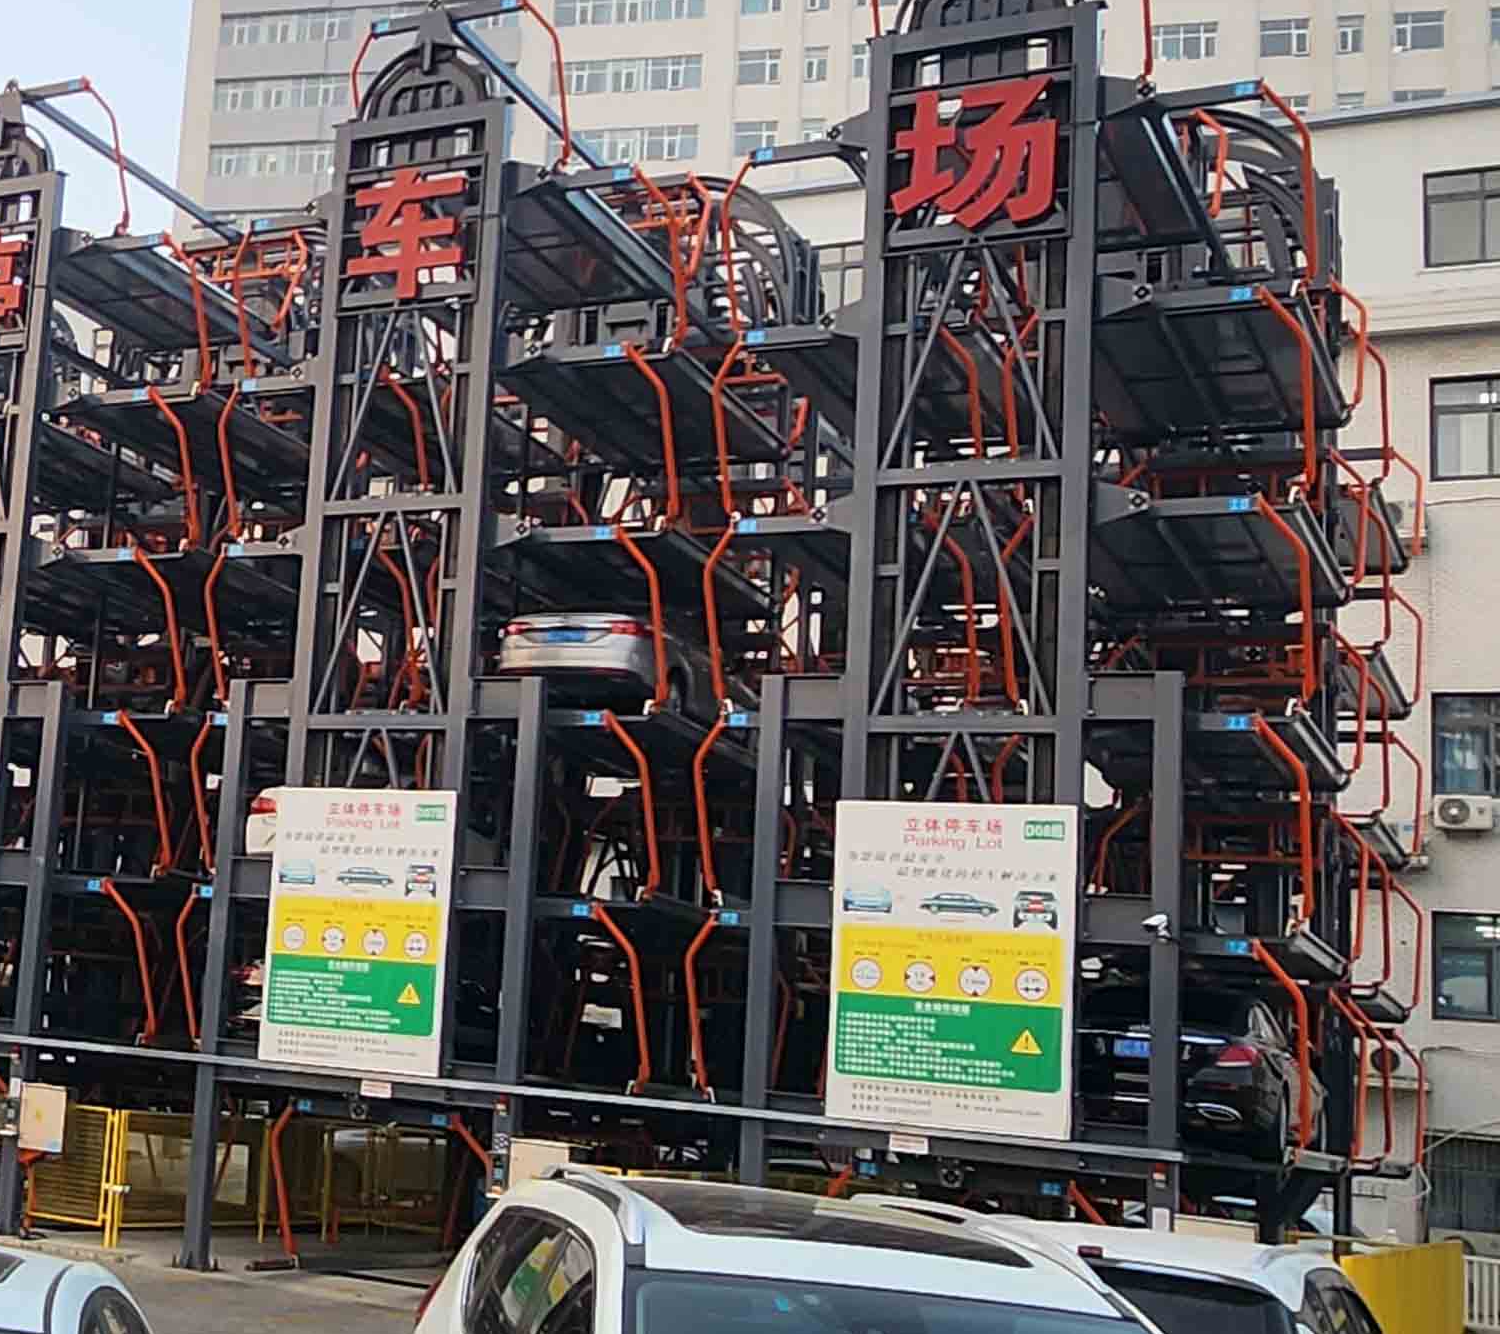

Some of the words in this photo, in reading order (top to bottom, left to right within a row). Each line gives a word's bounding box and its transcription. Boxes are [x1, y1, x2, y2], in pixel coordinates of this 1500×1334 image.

[902, 817, 1004, 836] 立体停车场
[902, 834, 967, 851] Parking
[975, 836, 1004, 849] Lot
